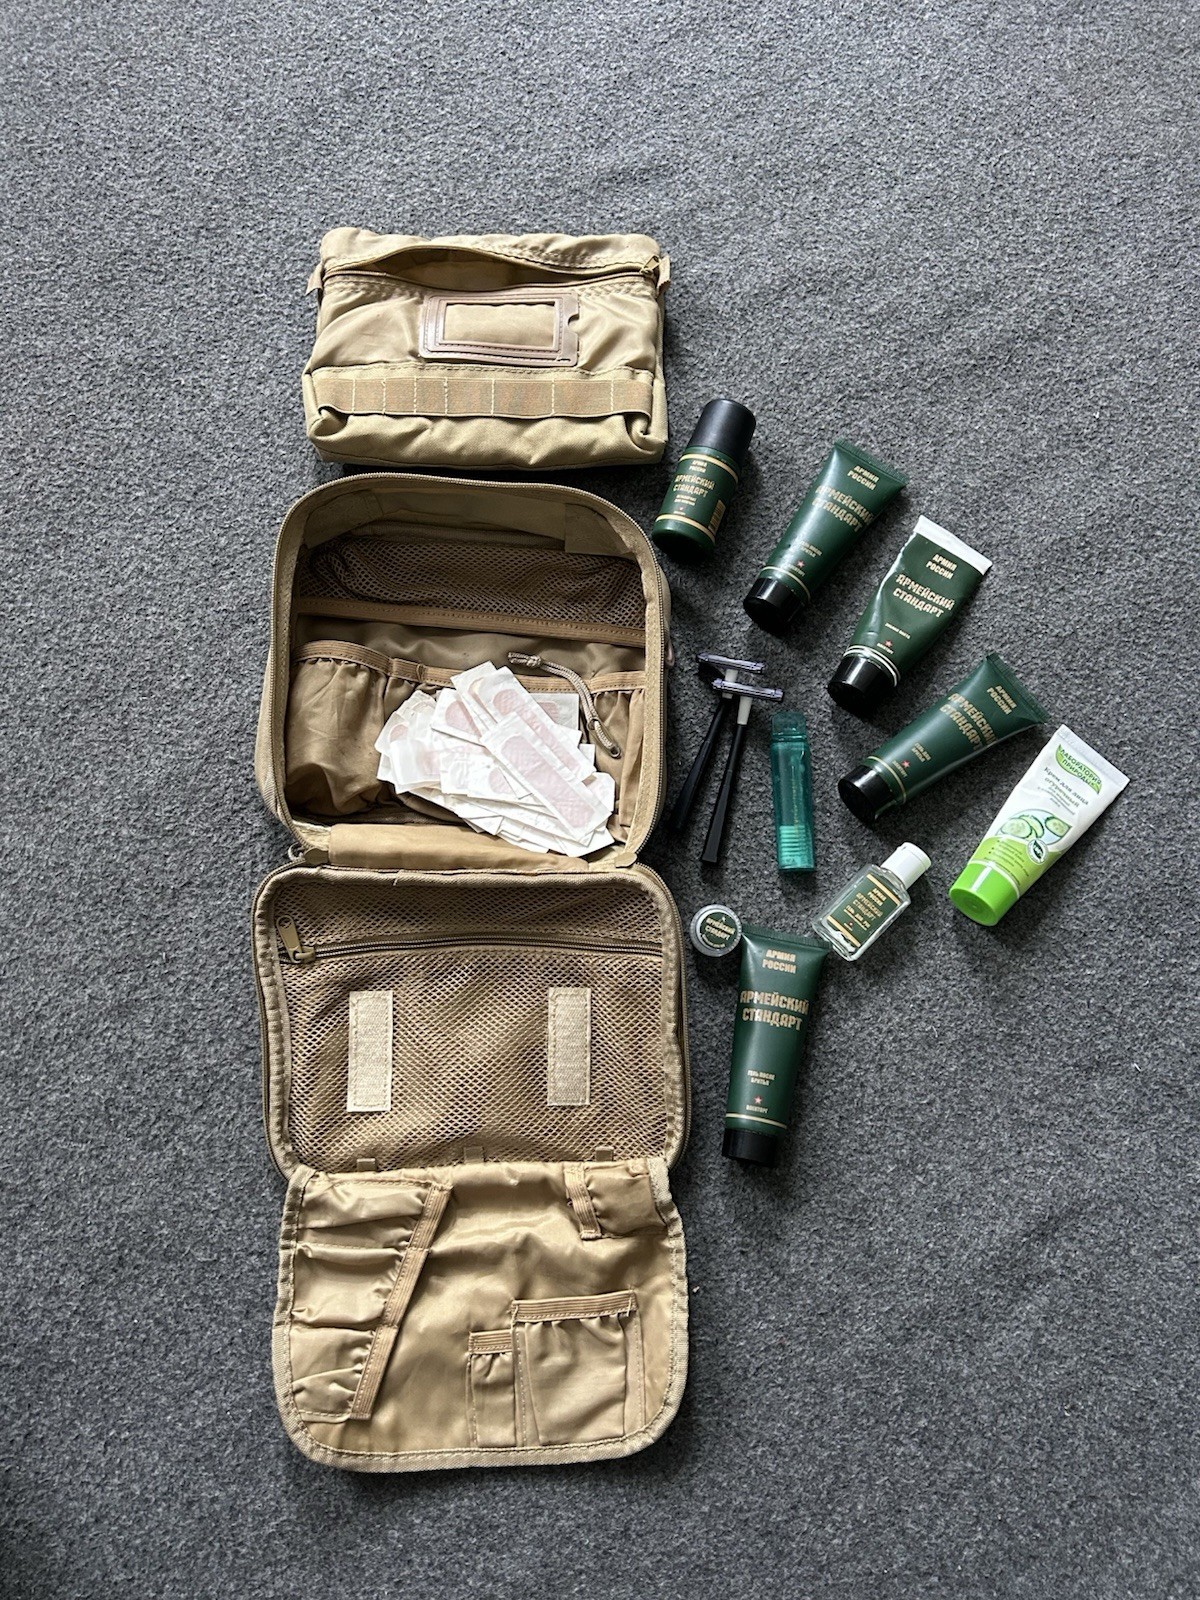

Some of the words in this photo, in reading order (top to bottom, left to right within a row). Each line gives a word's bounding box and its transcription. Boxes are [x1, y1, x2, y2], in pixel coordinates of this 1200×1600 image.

[674, 475, 715, 490] АРМЕЙСКИЙ
[847, 470, 876, 490] РОССИИ
[854, 465, 879, 482] АРМИЯ
[673, 484, 708, 497] СТАНДАРТ
[926, 561, 954, 579] РОССИИ
[932, 554, 957, 571] АРМИЯ
[893, 587, 944, 618] СТАНДАРТ
[896, 574, 955, 611] АРМЕЙСКИЙ
[986, 687, 1012, 715] РОССИИ
[995, 685, 1017, 709] АРМИЯ
[939, 704, 983, 750] СТАНДАРТ
[1060, 749, 1102, 785] ЛАБОРАТОРИЯ
[1062, 759, 1092, 785] ПРИРОДЫ
[1044, 767, 1060, 782] Крем
[1060, 782, 1073, 792] для
[1072, 792, 1089, 806] лица
[856, 892, 883, 917] АРМЕЙСКИЙ
[762, 959, 797, 974] РОССИИ
[765, 949, 796, 963] АРМИЯ
[739, 990, 809, 1015] АРМЕЙСКИЙ
[742, 1007, 802, 1031] СТАНДАРТ
